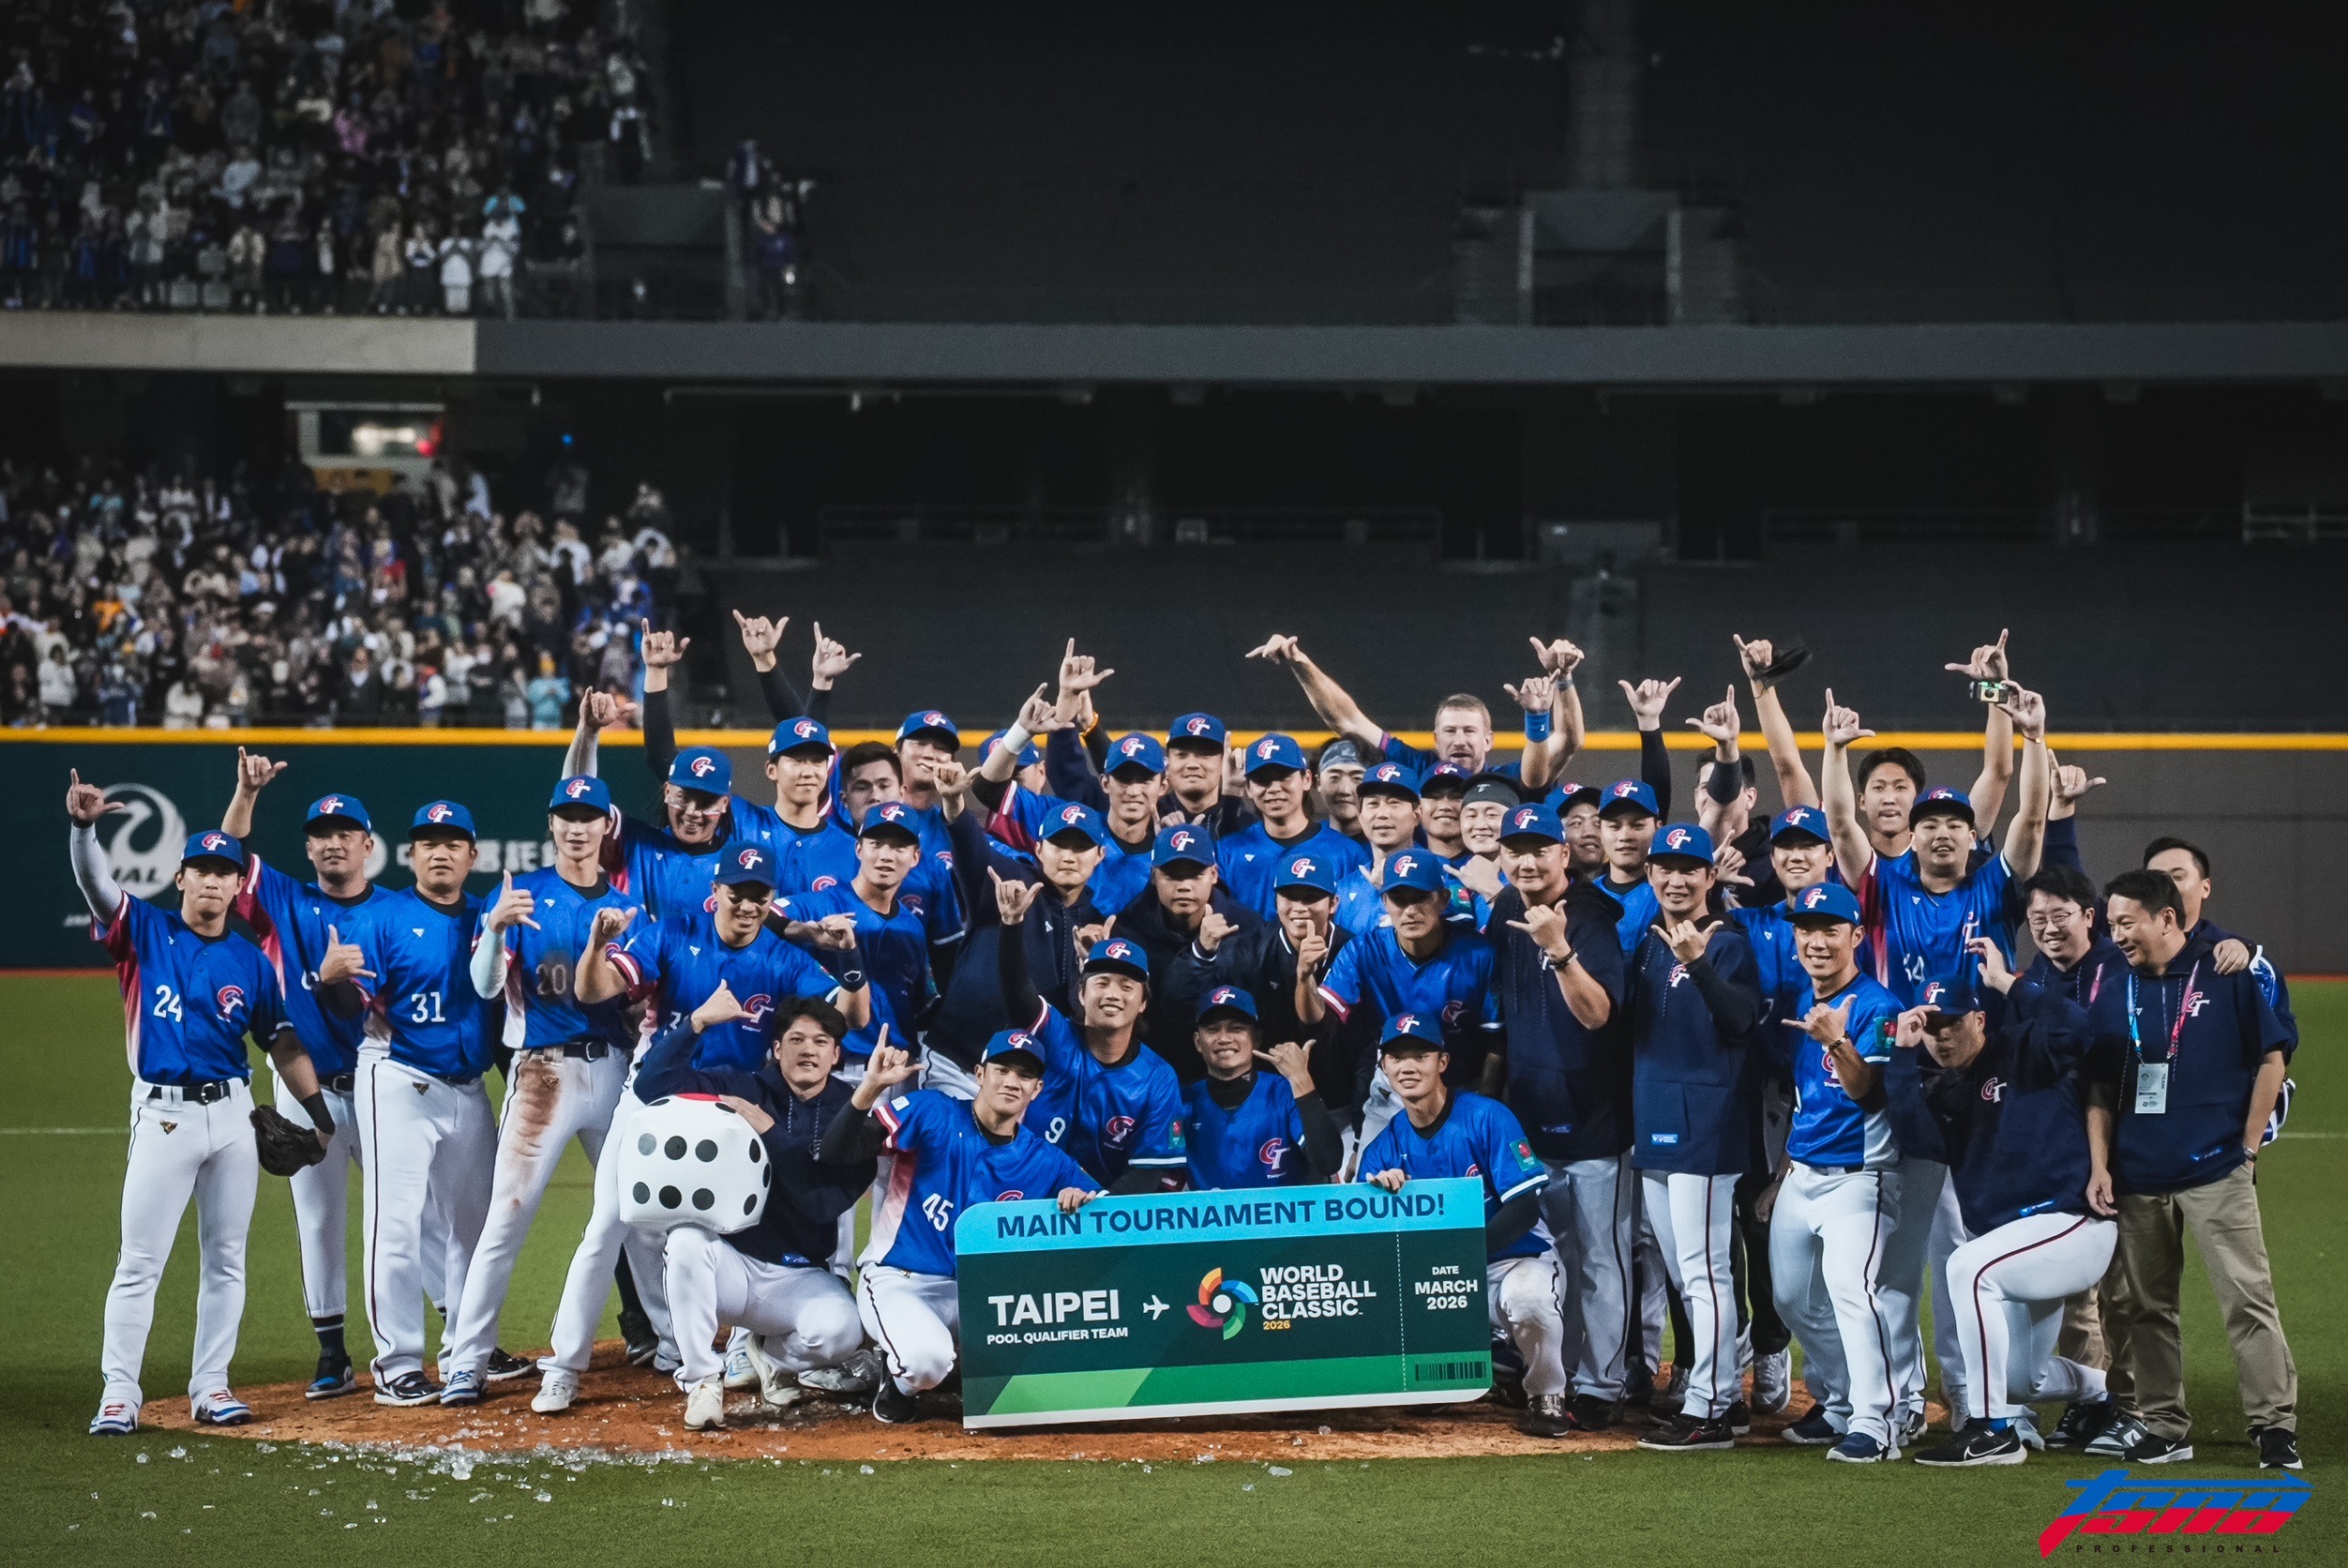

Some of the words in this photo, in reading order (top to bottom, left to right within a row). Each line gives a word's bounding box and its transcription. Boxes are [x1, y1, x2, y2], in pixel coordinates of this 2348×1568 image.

[535, 963, 567, 996] 20
[154, 985, 182, 1022] 24
[411, 991, 445, 1023] 31
[1045, 1116, 1066, 1143] 9
[923, 1193, 954, 1231] 45
[997, 1213, 1081, 1239] MAIN
[1090, 1200, 1317, 1233] TOURNAMENT
[1325, 1192, 1445, 1222] BOUND!
[1259, 1264, 1344, 1285] WORLD
[1432, 1265, 1459, 1275] DATE
[1261, 1280, 1377, 1303] BASEBALL
[1415, 1279, 1479, 1295] MARCH
[987, 1289, 1120, 1326] TAIPEI
[1261, 1299, 1359, 1320] CLASSIC
[1426, 1295, 1468, 1310] 2026
[986, 1334, 1022, 1345] POOL
[1023, 1329, 1090, 1344] QUALIFIER
[1091, 1327, 1128, 1339] TEAM
[1262, 1319, 1291, 1331] 2026
